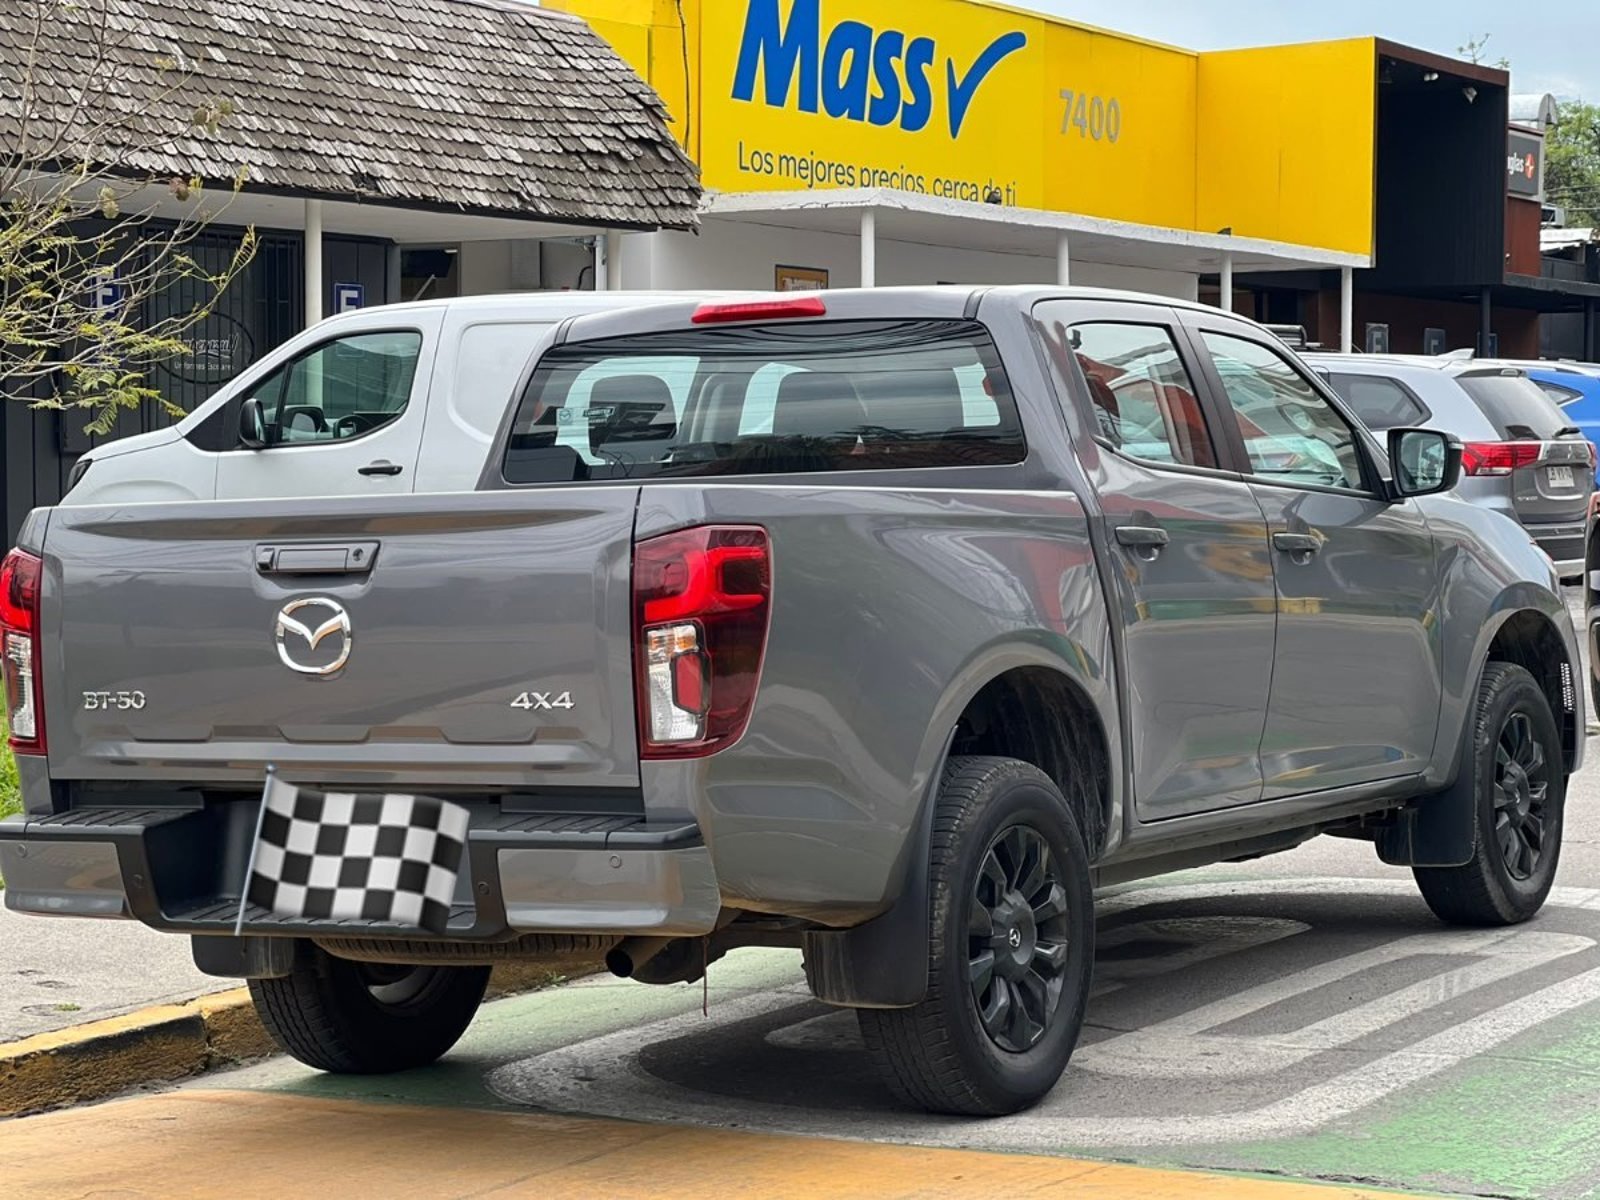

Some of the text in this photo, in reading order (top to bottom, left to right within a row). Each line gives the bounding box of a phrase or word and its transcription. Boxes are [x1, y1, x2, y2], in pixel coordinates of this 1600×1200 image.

[732, 0, 935, 131] Mass
[1060, 89, 1121, 142] 7400
[739, 141, 774, 174] Los
[778, 150, 855, 189] mejores
[933, 177, 979, 201] cerca
[82, 690, 146, 709] BT-50
